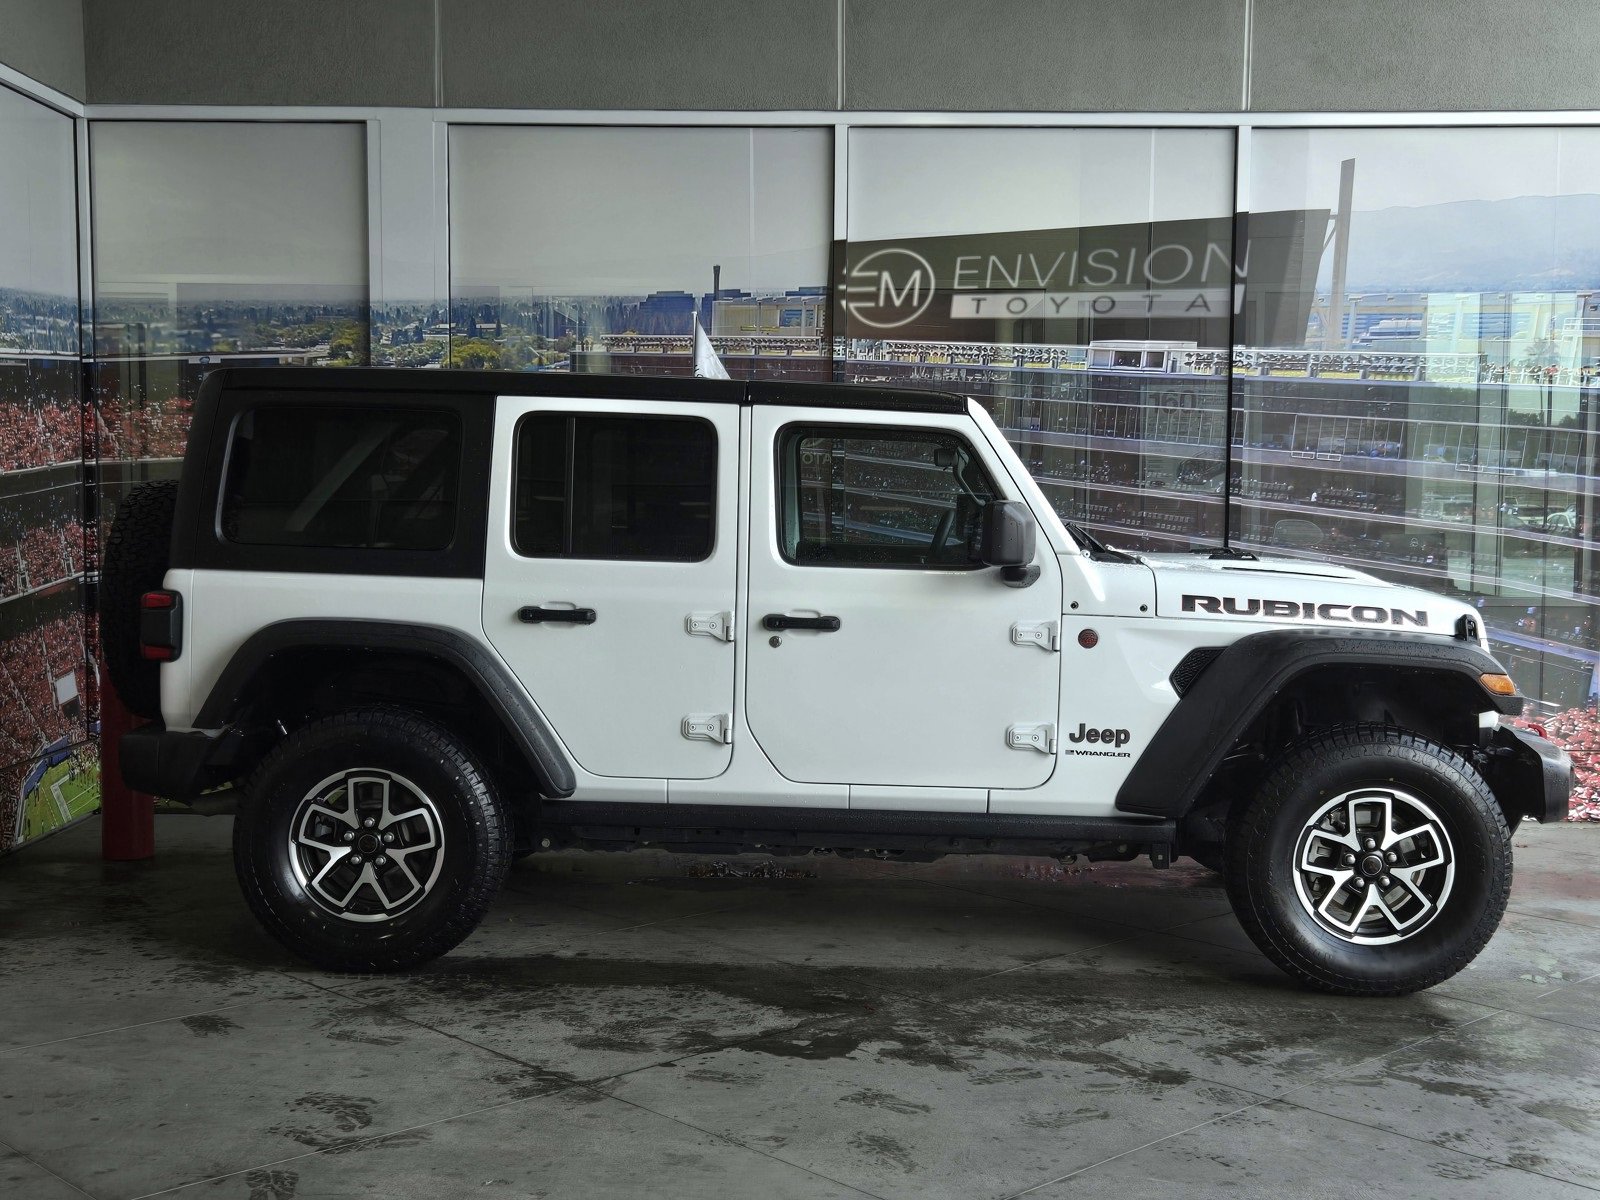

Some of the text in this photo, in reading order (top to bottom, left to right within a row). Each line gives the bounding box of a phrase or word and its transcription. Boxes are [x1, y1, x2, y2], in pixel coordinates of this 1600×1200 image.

[953, 239, 1251, 290] ENVISION
[970, 293, 1212, 315] TOYOTA
[1181, 594, 1429, 627] RUBICON
[1069, 723, 1131, 748] Jeep
[1075, 750, 1131, 758] WRANGLER
